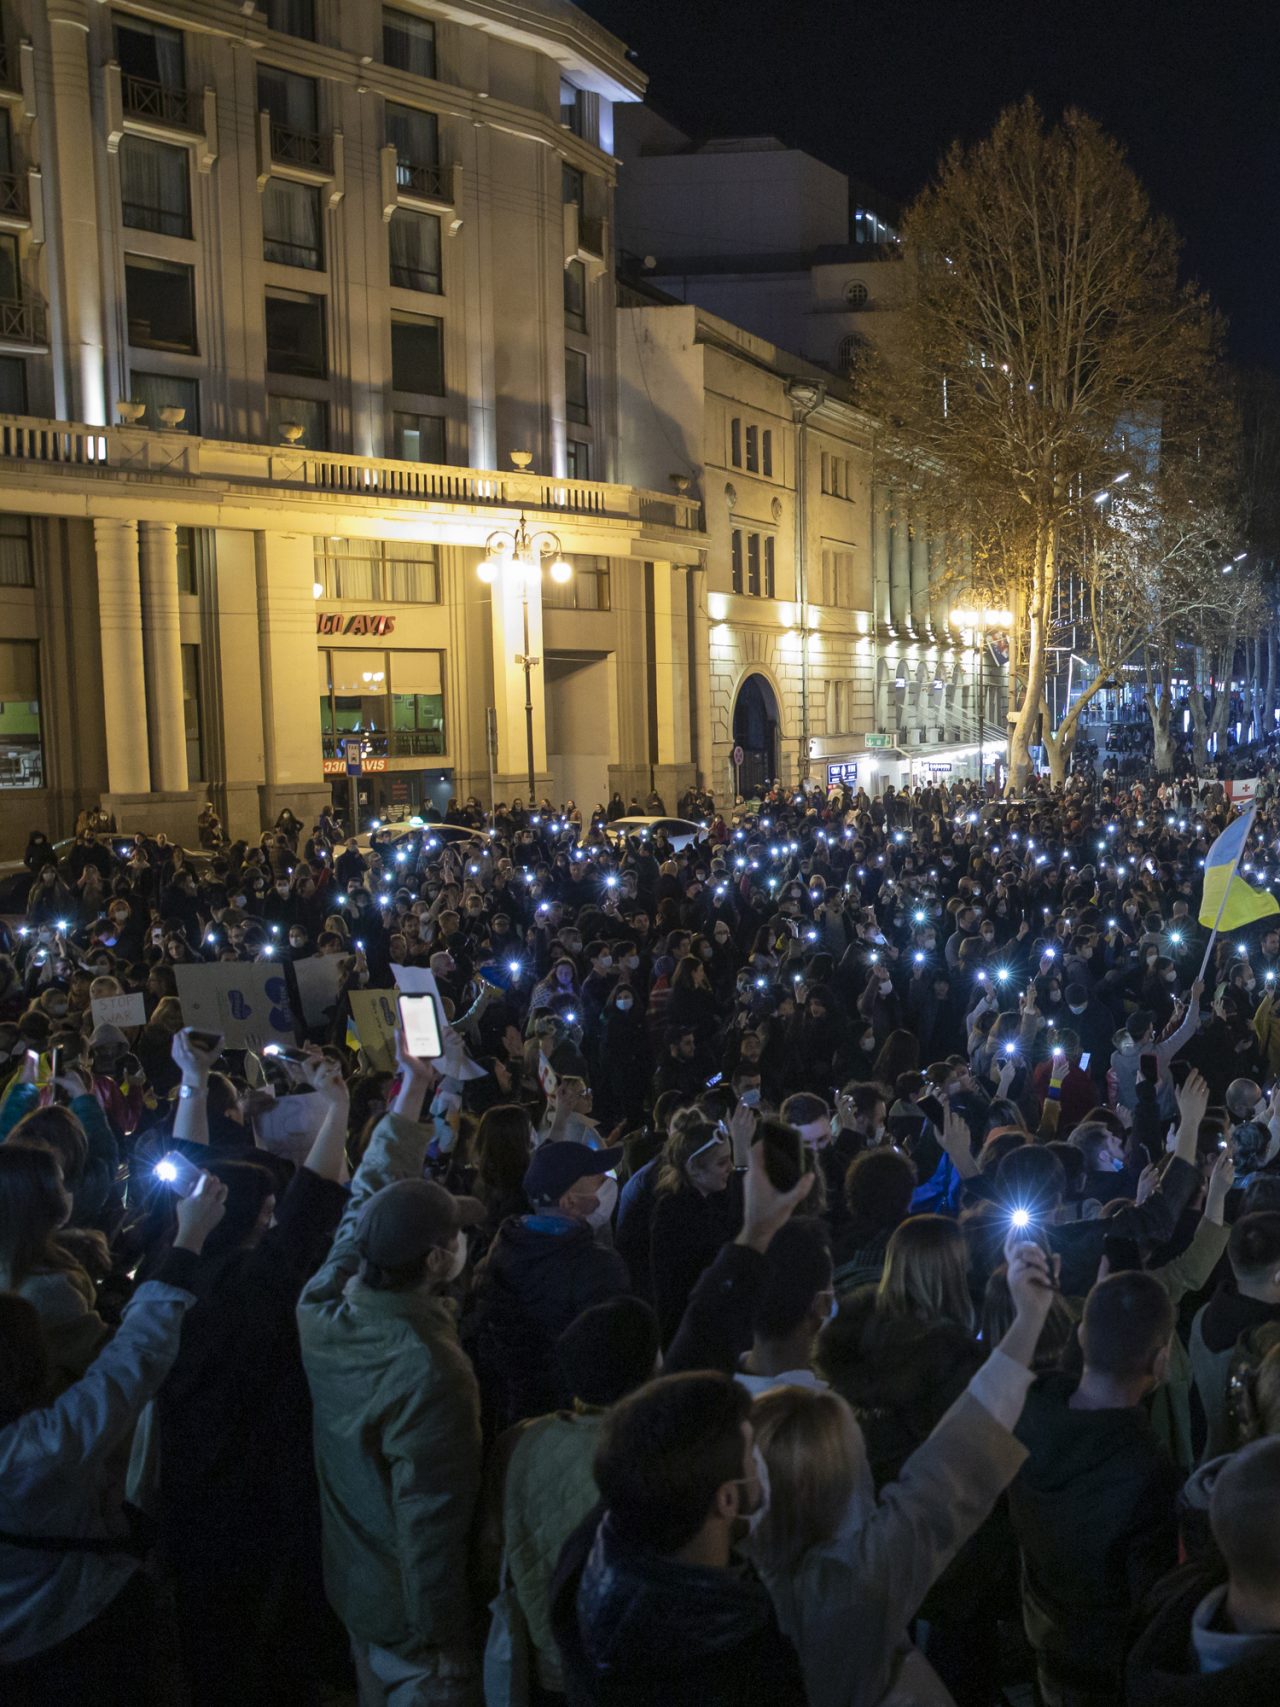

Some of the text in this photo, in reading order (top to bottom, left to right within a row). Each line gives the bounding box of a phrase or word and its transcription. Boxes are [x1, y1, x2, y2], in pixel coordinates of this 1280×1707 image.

[347, 615, 396, 635] AVIS
[99, 995, 135, 1011] STOP
[100, 1011, 132, 1024] WAR
